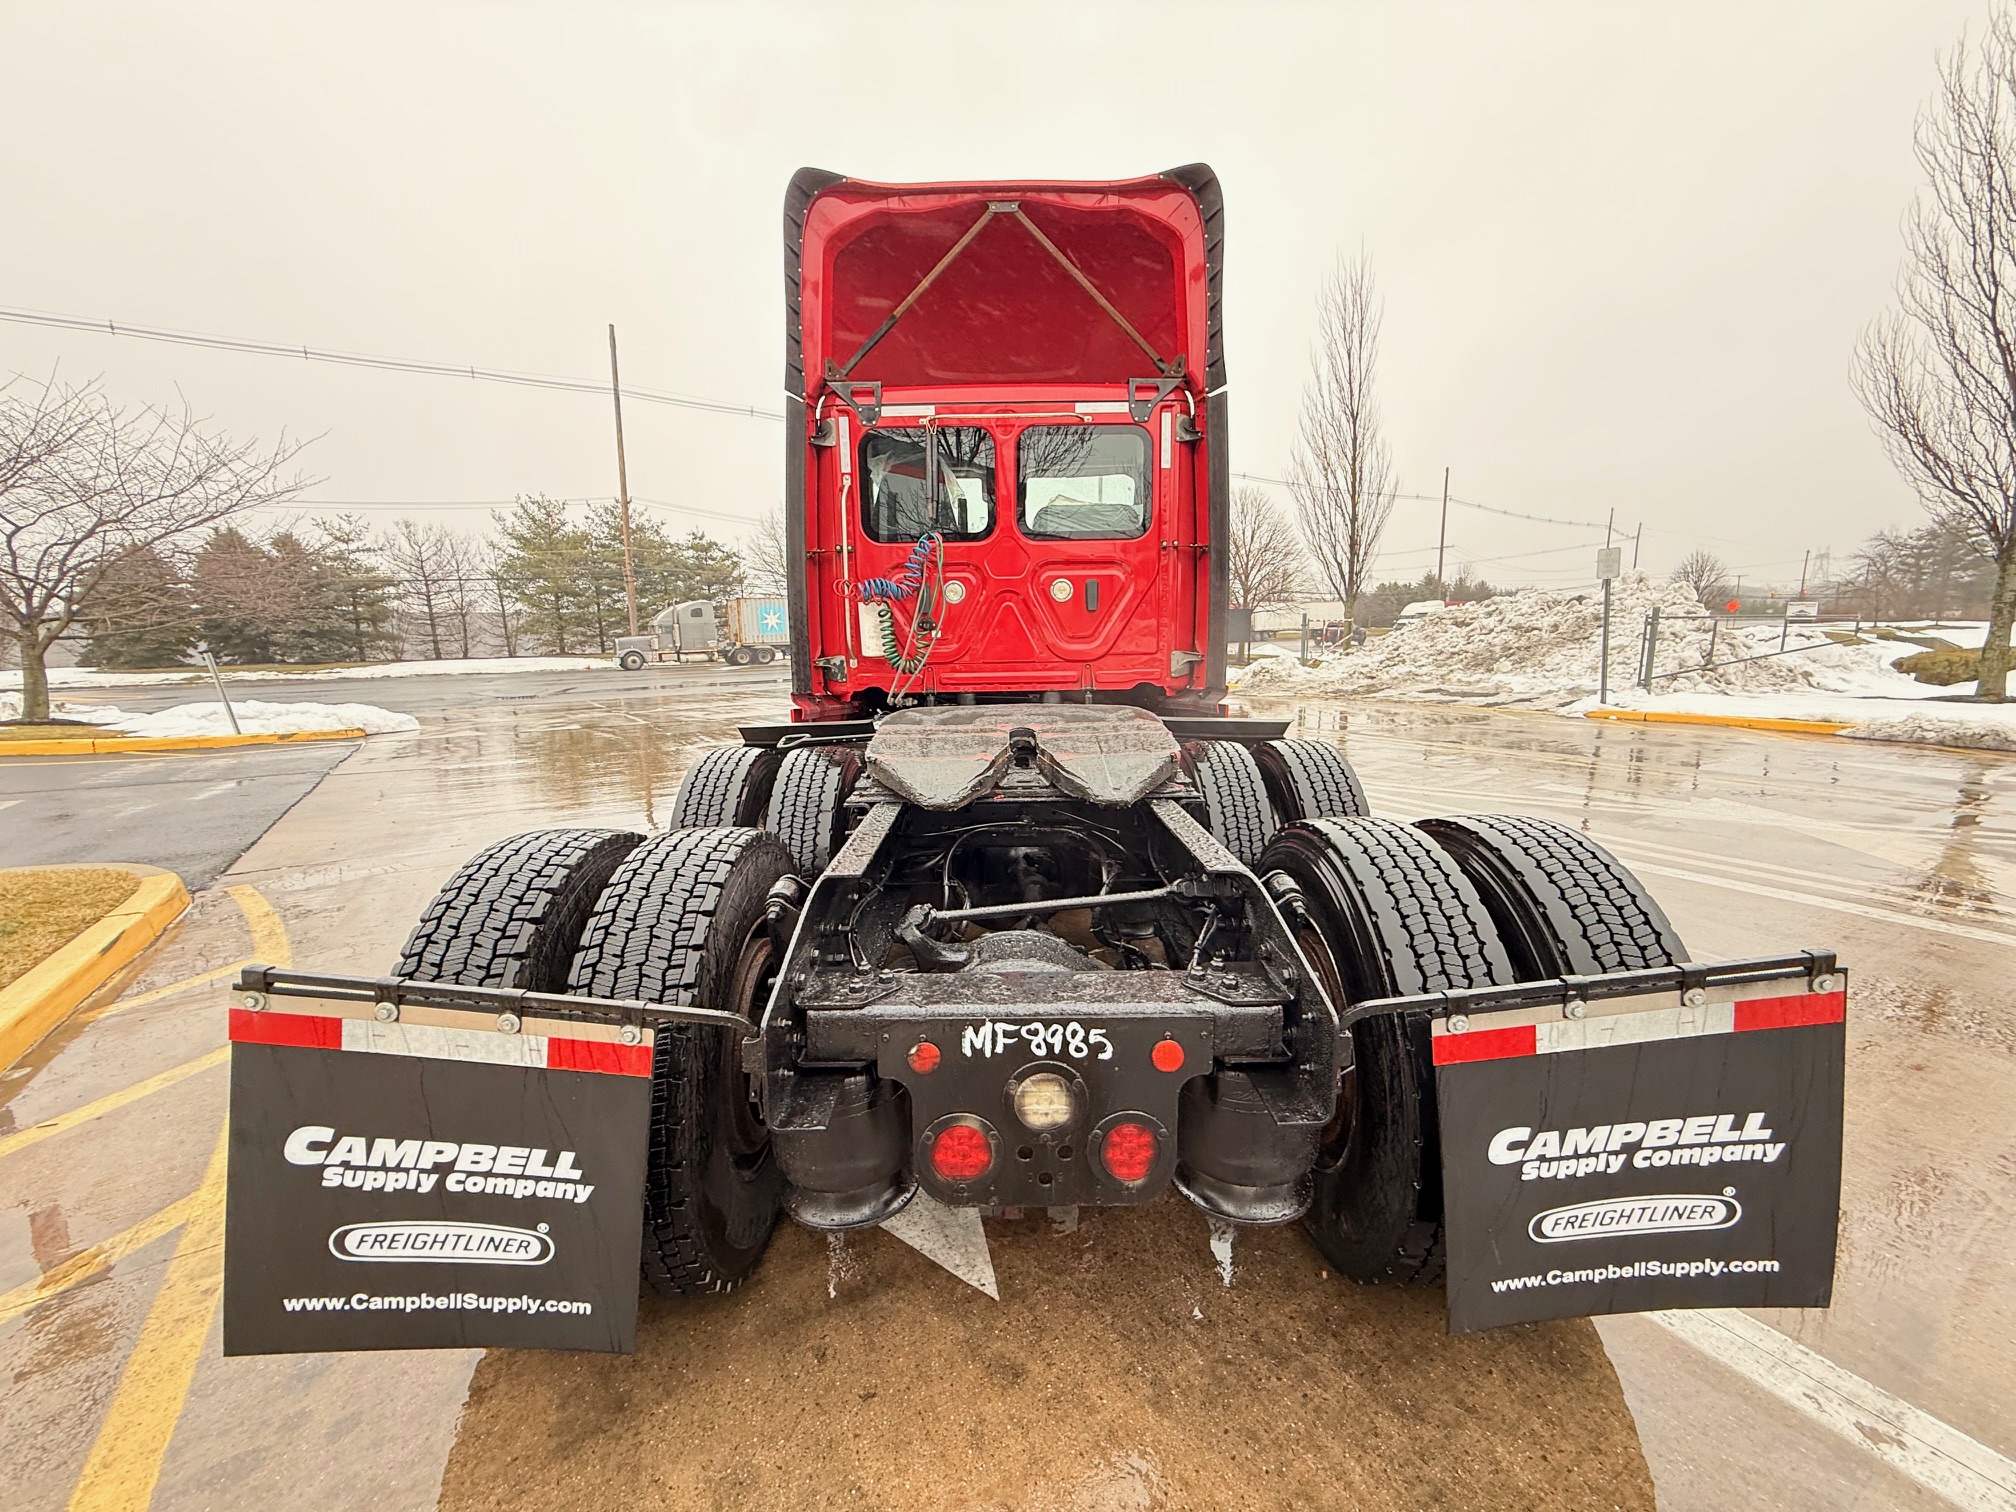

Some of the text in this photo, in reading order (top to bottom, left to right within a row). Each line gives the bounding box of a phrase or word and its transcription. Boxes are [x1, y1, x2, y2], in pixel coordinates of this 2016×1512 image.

[961, 1021, 1114, 1060] MF8985
[283, 1125, 584, 1180] CAMPBELL
[1488, 1112, 1773, 1165] CAMPBELL
[1520, 1141, 1786, 1181] Supply Company
[321, 1167, 595, 1204] Supply Company
[1550, 1203, 1717, 1233] FREIGHTLINER
[354, 1232, 532, 1256] FREIGHTLINER
[1490, 1258, 1780, 1293] www.CampbellSupply.com
[283, 1292, 593, 1316] www.CampbellSupply.com
